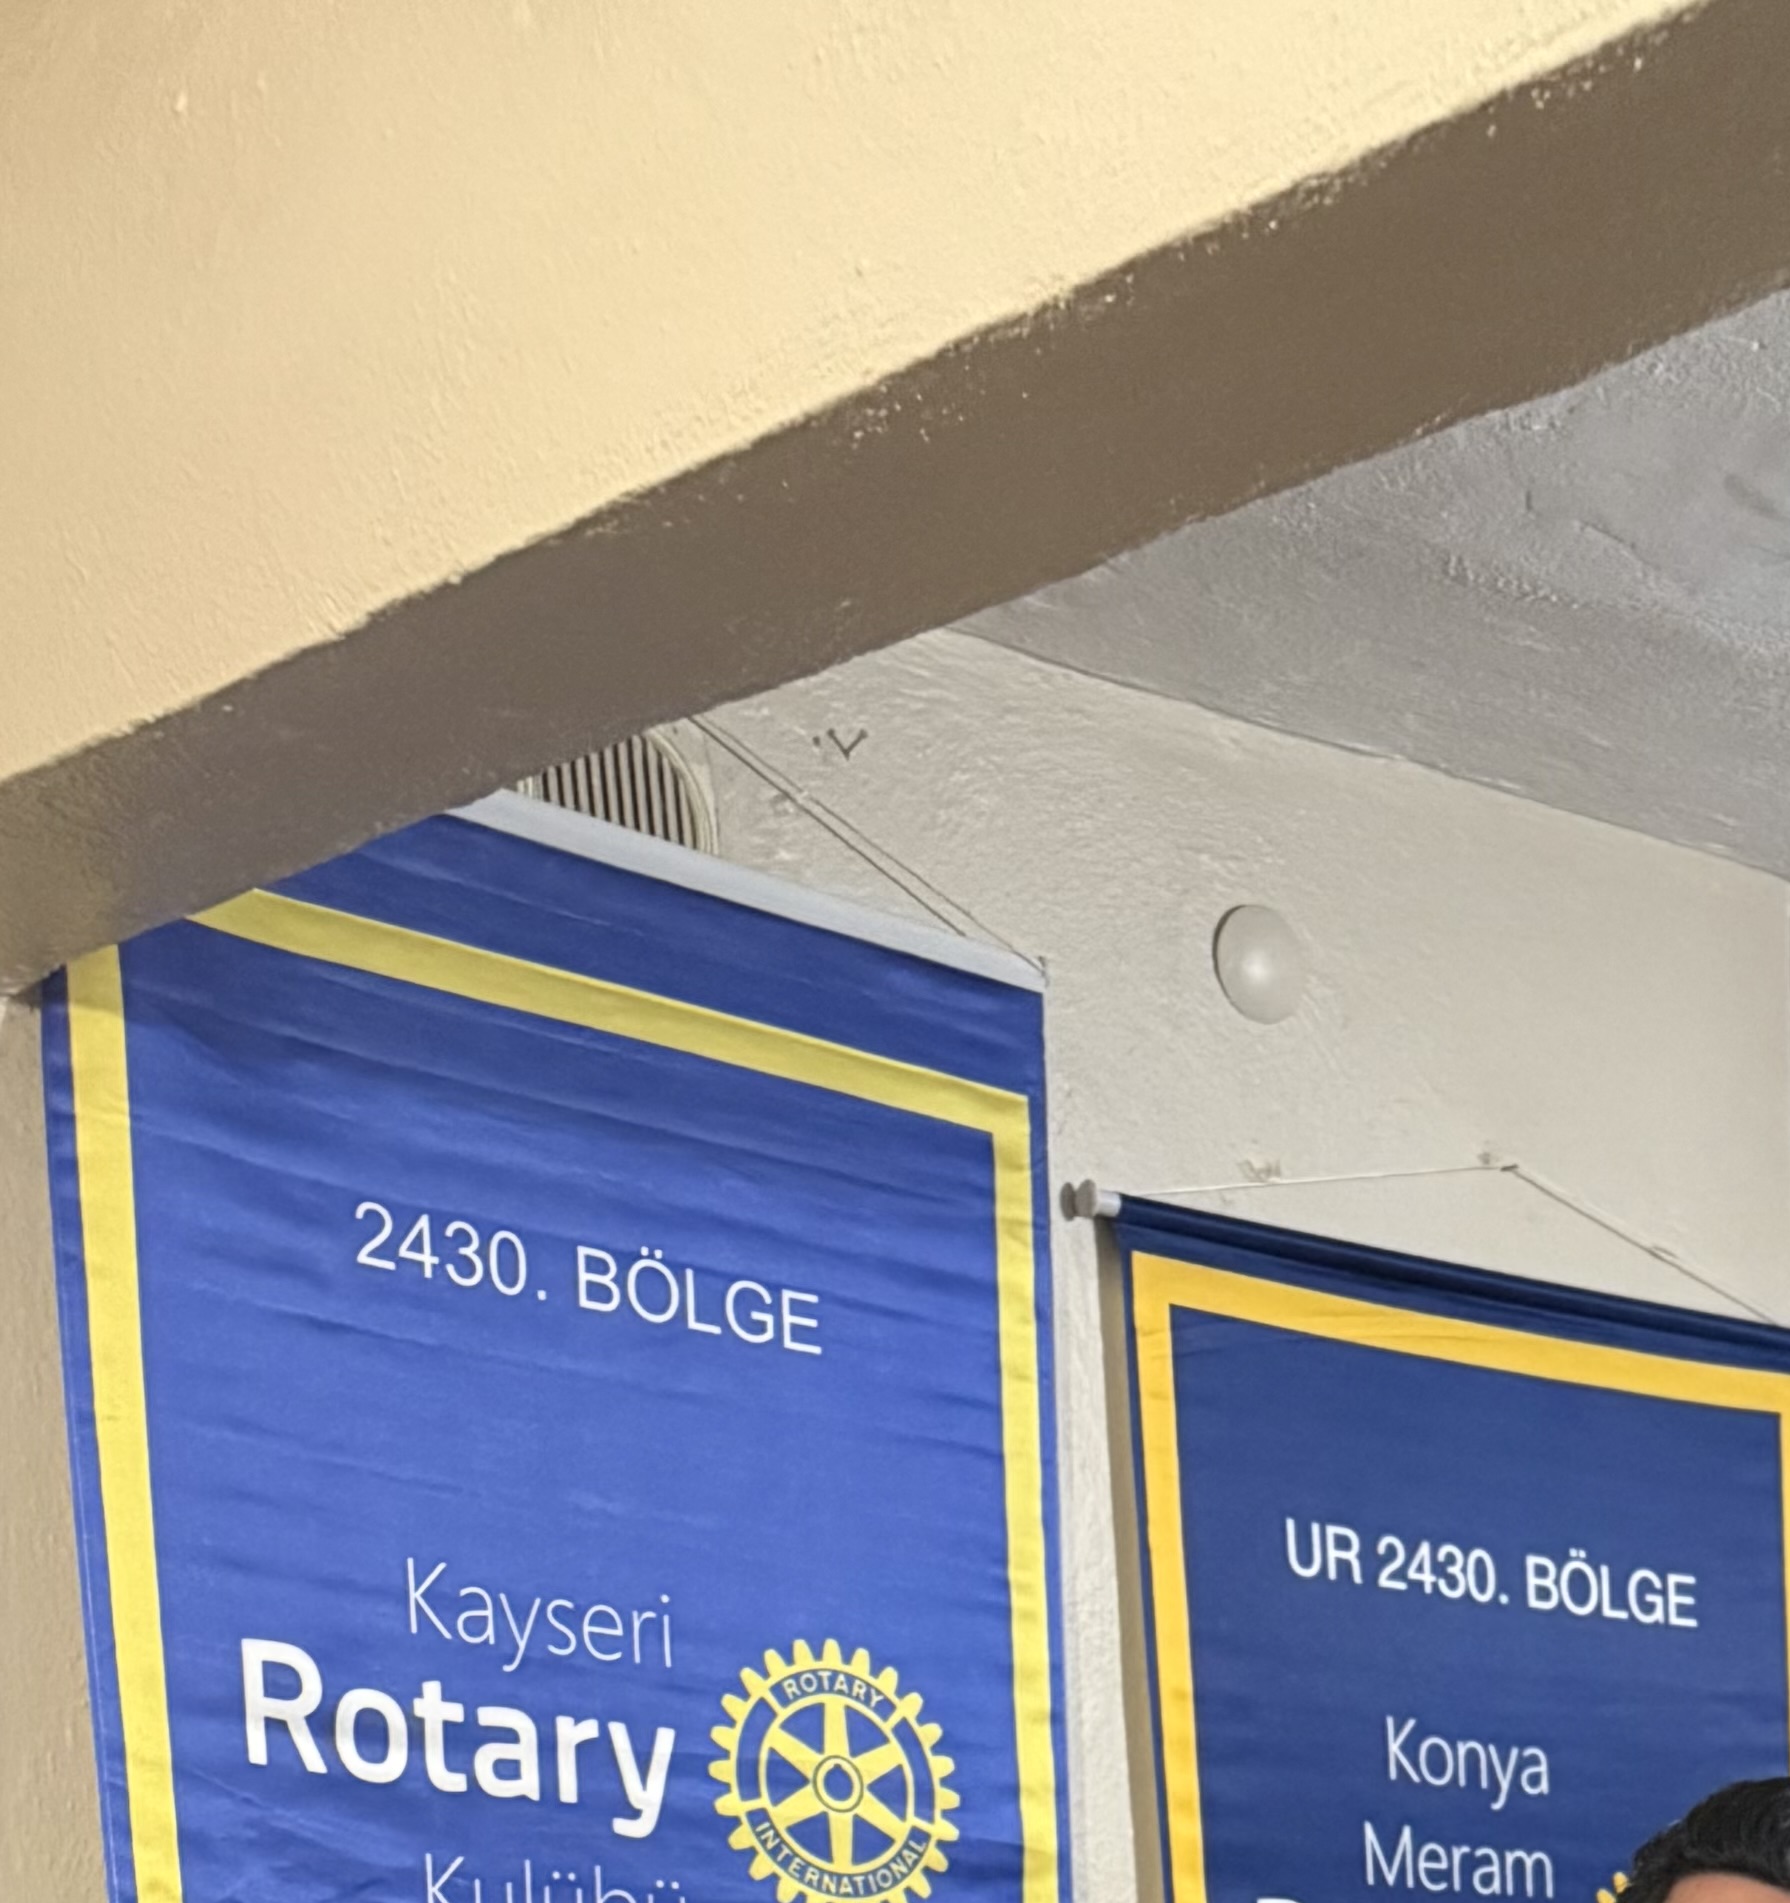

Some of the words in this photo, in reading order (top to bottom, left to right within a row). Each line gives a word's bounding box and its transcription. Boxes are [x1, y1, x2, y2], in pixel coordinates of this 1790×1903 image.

[355, 1201, 547, 1301] 2430.
[576, 1245, 822, 1355] BÖLGE
[406, 1557, 672, 1671] Kayseri
[1285, 1517, 1363, 1585] UR
[1376, 1535, 1509, 1605] 2430.
[1525, 1548, 1698, 1628] BÖLGE
[240, 1638, 676, 1839] Rotary
[782, 1670, 885, 1708] ROTARY
[1385, 1715, 1550, 1811] Konya
[755, 1822, 927, 1896] INTERNATIONAL
[1363, 1821, 1554, 1899] Meram
